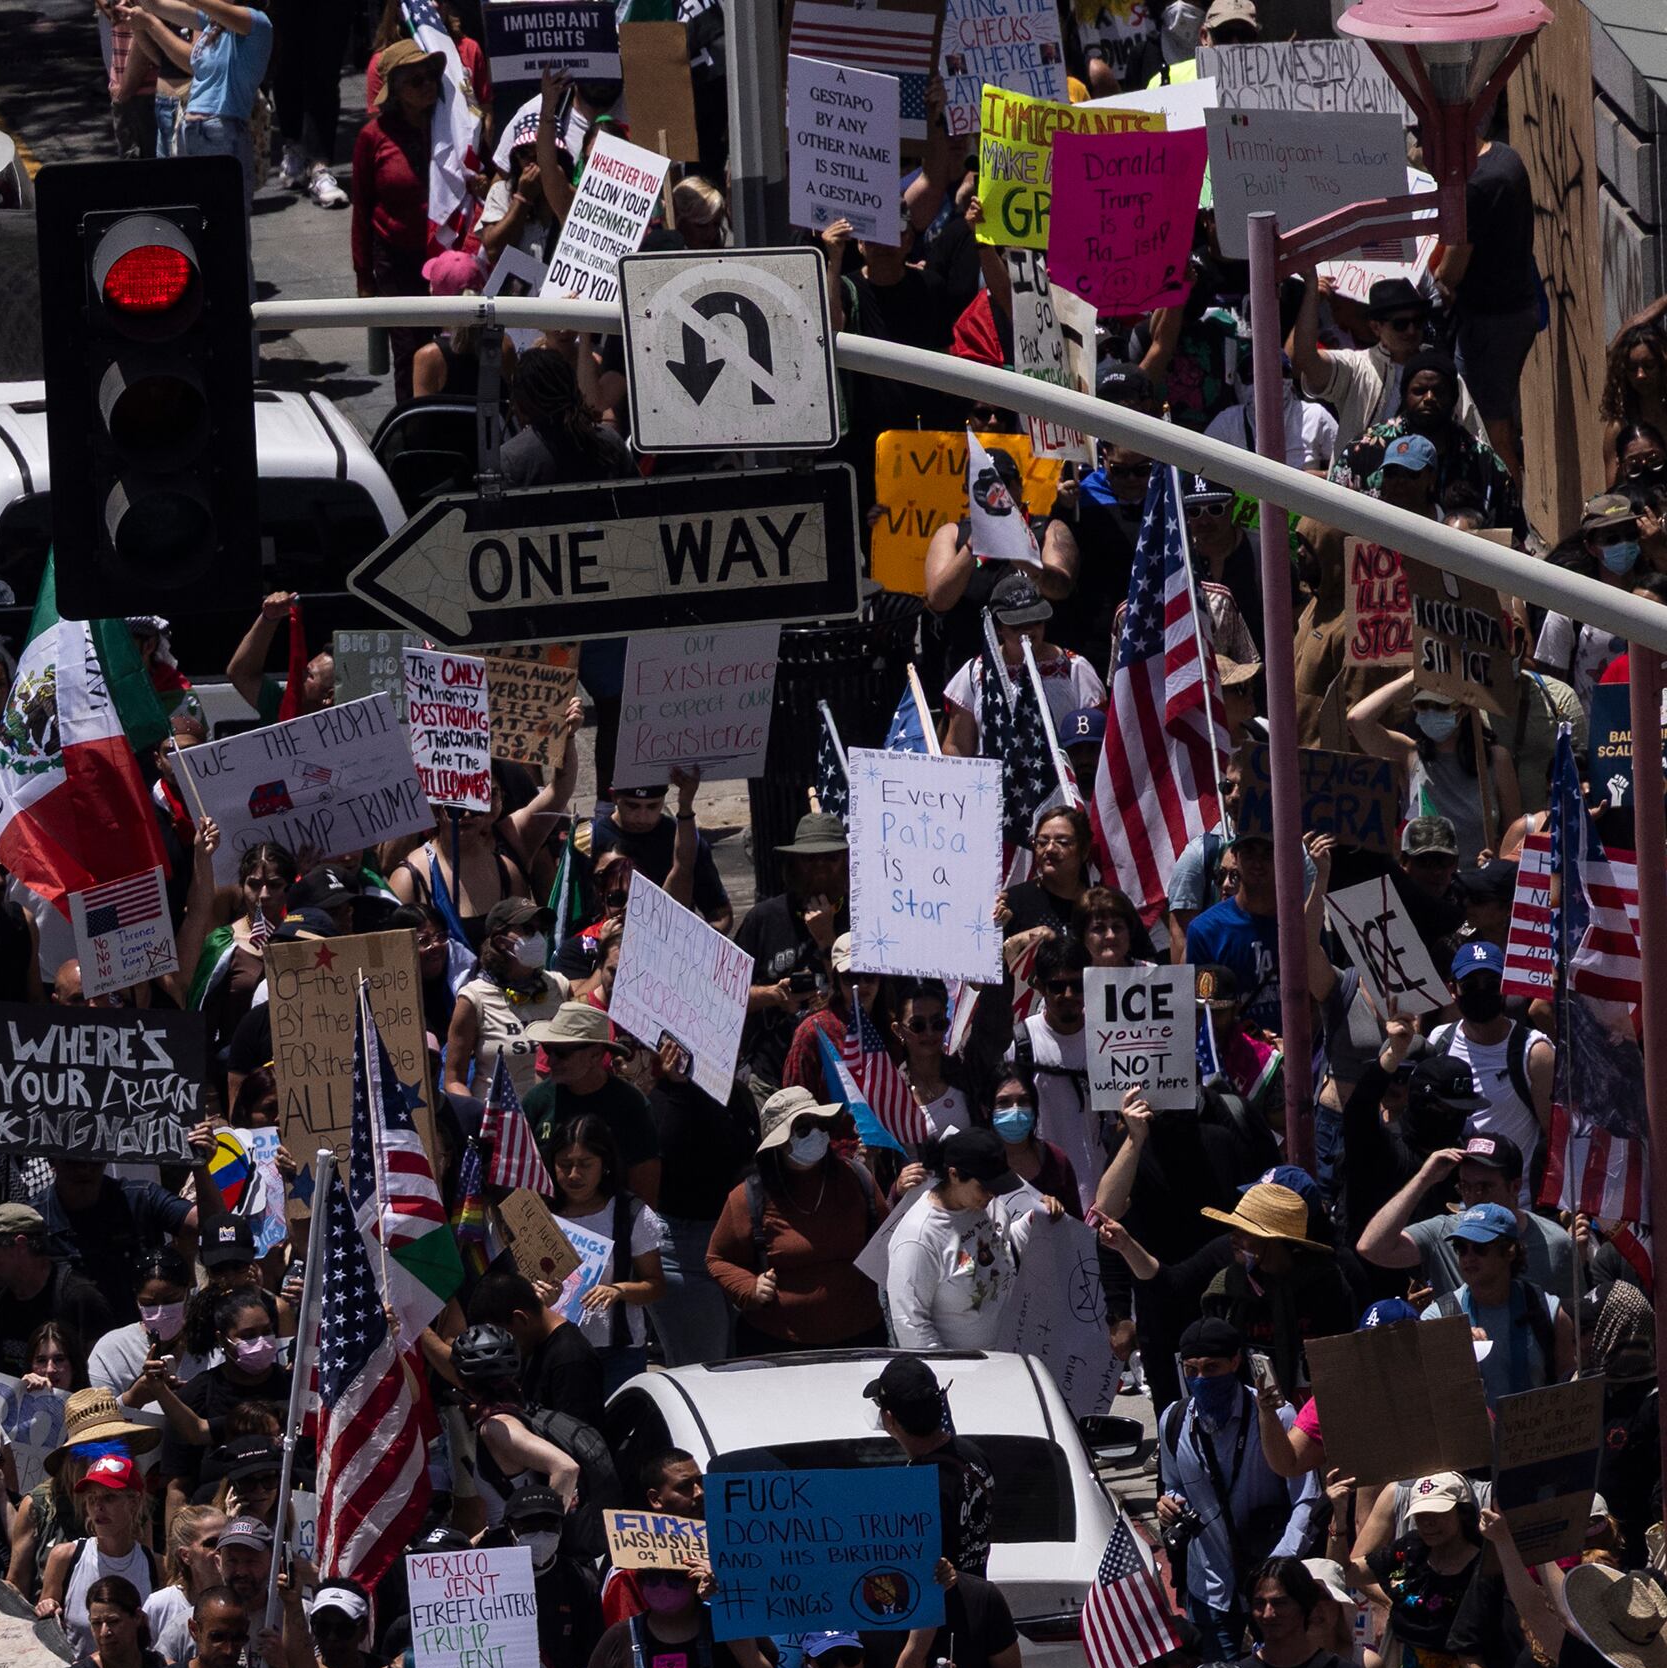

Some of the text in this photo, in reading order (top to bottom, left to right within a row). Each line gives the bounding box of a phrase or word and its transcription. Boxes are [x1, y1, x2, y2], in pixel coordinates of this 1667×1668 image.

[836, 69, 846, 84] A
[810, 86, 873, 113] GESTAPO
[816, 112, 867, 135] BY ANY
[798, 132, 890, 164] OTHER NAME
[590, 152, 659, 194] WHATEVER YOU
[816, 159, 868, 183] IS STILL
[582, 175, 650, 218] ALLOW YOUR
[806, 181, 882, 209] A GESTAPO
[567, 221, 577, 238] TO
[577, 226, 589, 243] DO
[590, 232, 600, 248] TO
[574, 199, 642, 241] GOVERNMENT
[559, 242, 574, 256] THEY
[574, 249, 587, 264] WILL
[550, 260, 571, 287] DO
[570, 267, 589, 293] TO
[469, 512, 808, 603] ONE WAY
[882, 780, 966, 820] Every
[878, 845, 951, 886] is a
[1105, 983, 1174, 1022] ICE
[1111, 1053, 1172, 1077] NOT
[1094, 1077, 1188, 1090] welcome here
